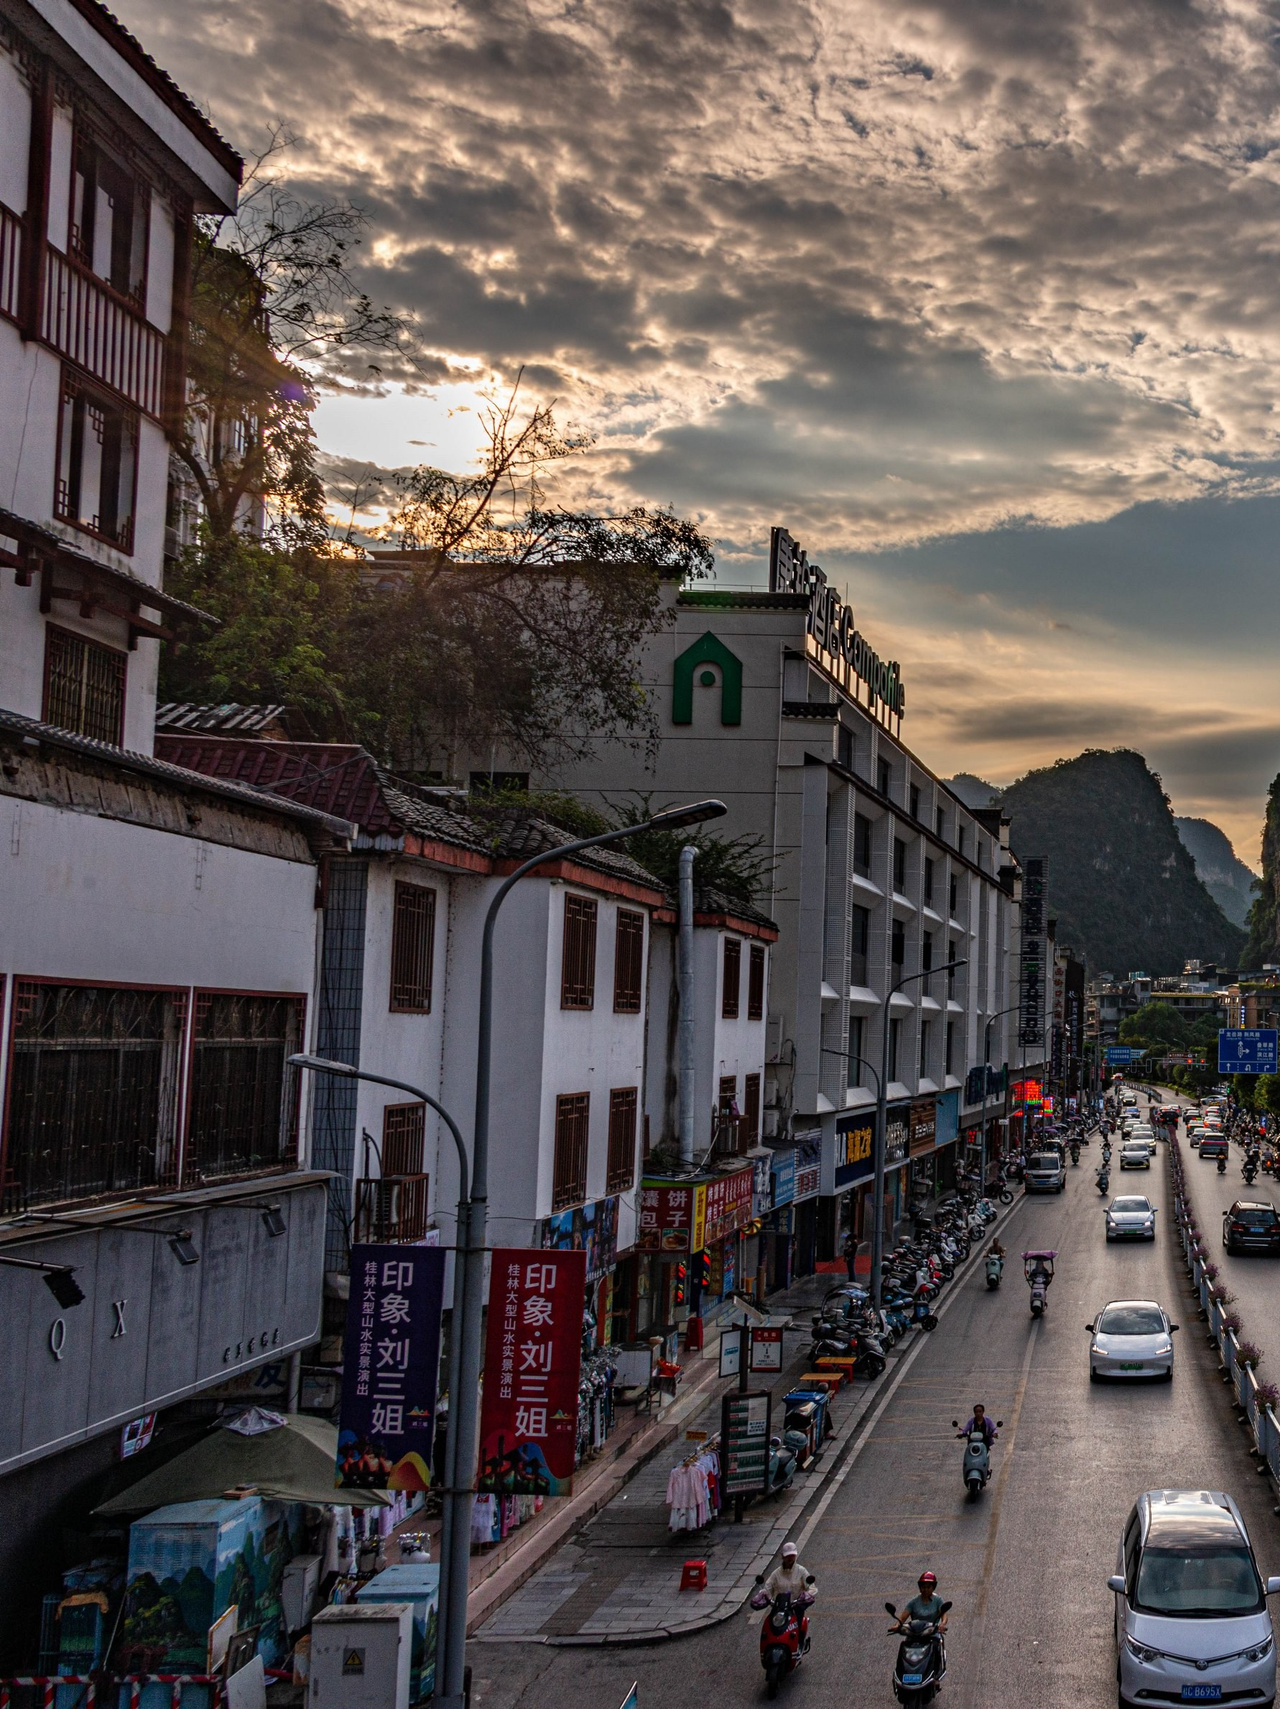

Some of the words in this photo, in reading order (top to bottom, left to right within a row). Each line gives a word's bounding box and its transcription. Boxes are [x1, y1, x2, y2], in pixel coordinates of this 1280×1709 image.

[356, 1260, 378, 1396] 桂林大型山水实景演出
[371, 1260, 414, 1435] 印象·刘三姐
[500, 1263, 521, 1399] 桂林大型山水实景演出
[515, 1262, 557, 1437] 印象·刘三姐
